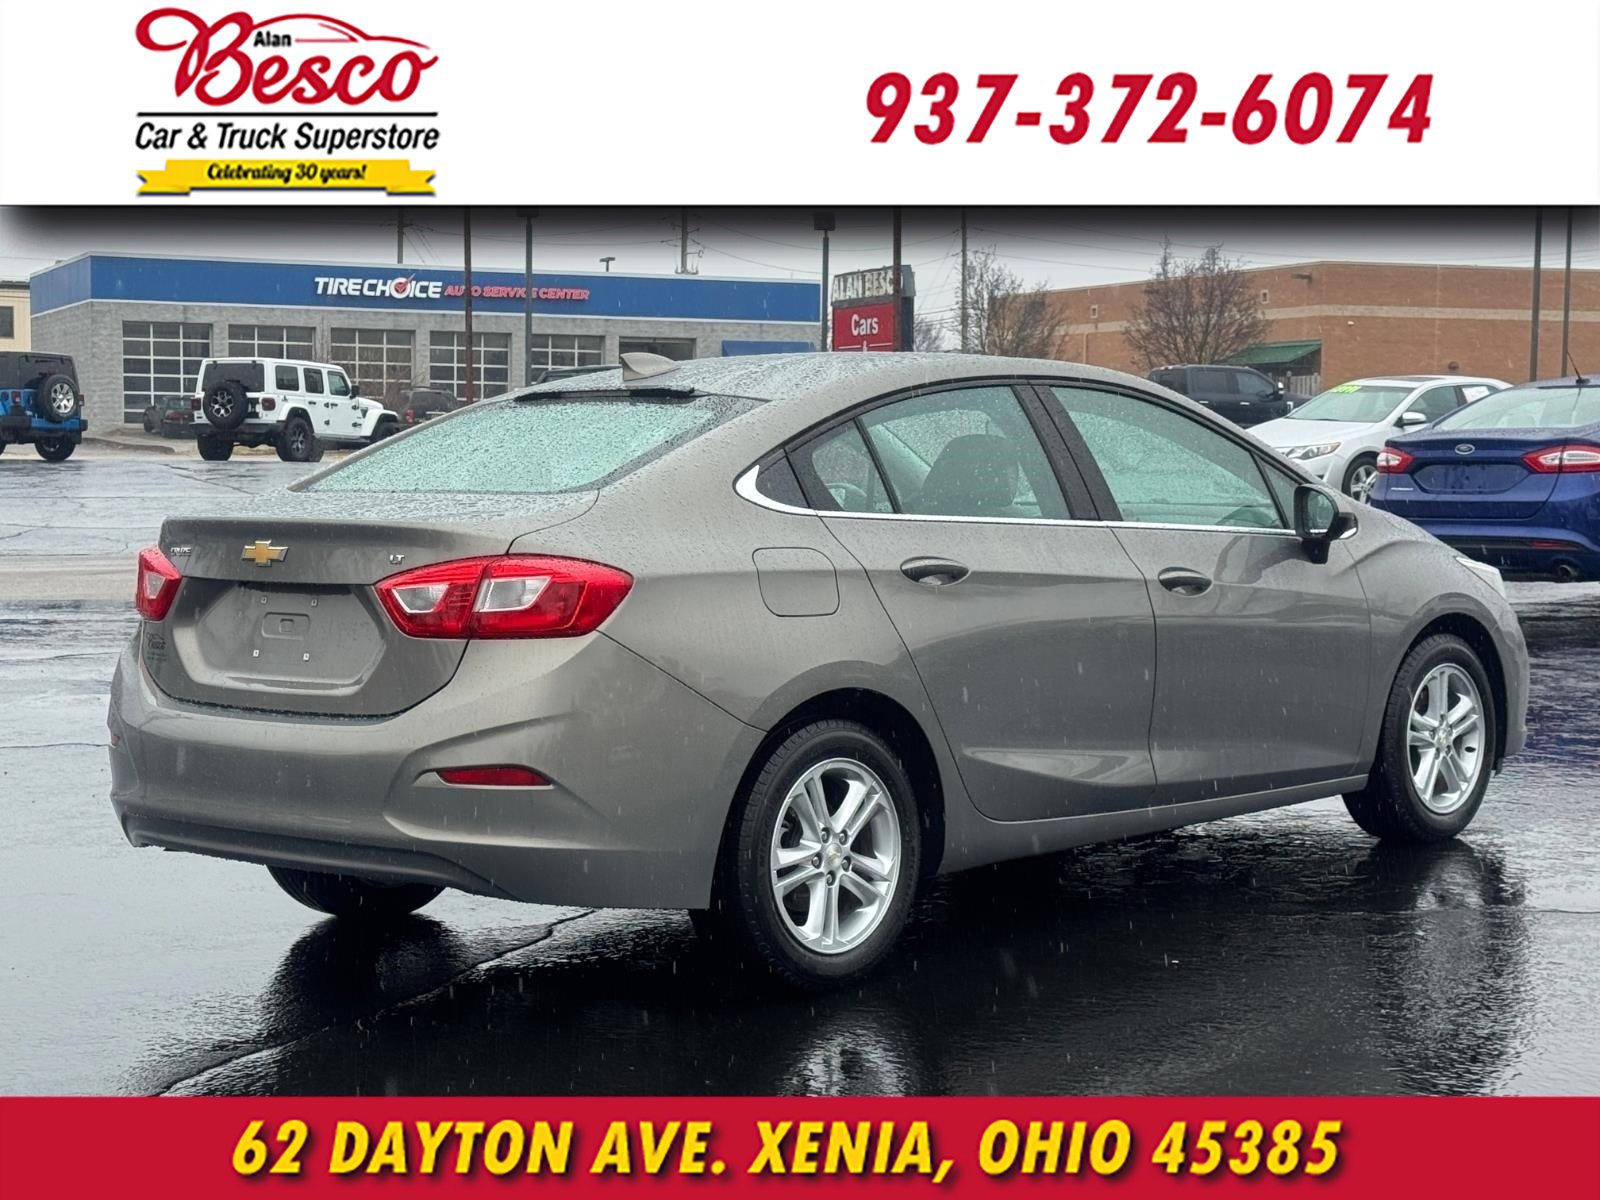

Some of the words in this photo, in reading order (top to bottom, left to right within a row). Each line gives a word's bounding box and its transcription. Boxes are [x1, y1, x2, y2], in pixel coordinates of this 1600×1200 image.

[444, 285, 482, 297] AUO
[539, 288, 590, 300] CENTER
[832, 274, 862, 302] ALAN
[864, 269, 903, 297] BESC
[851, 313, 879, 336] Cars
[389, 554, 405, 564] LT
